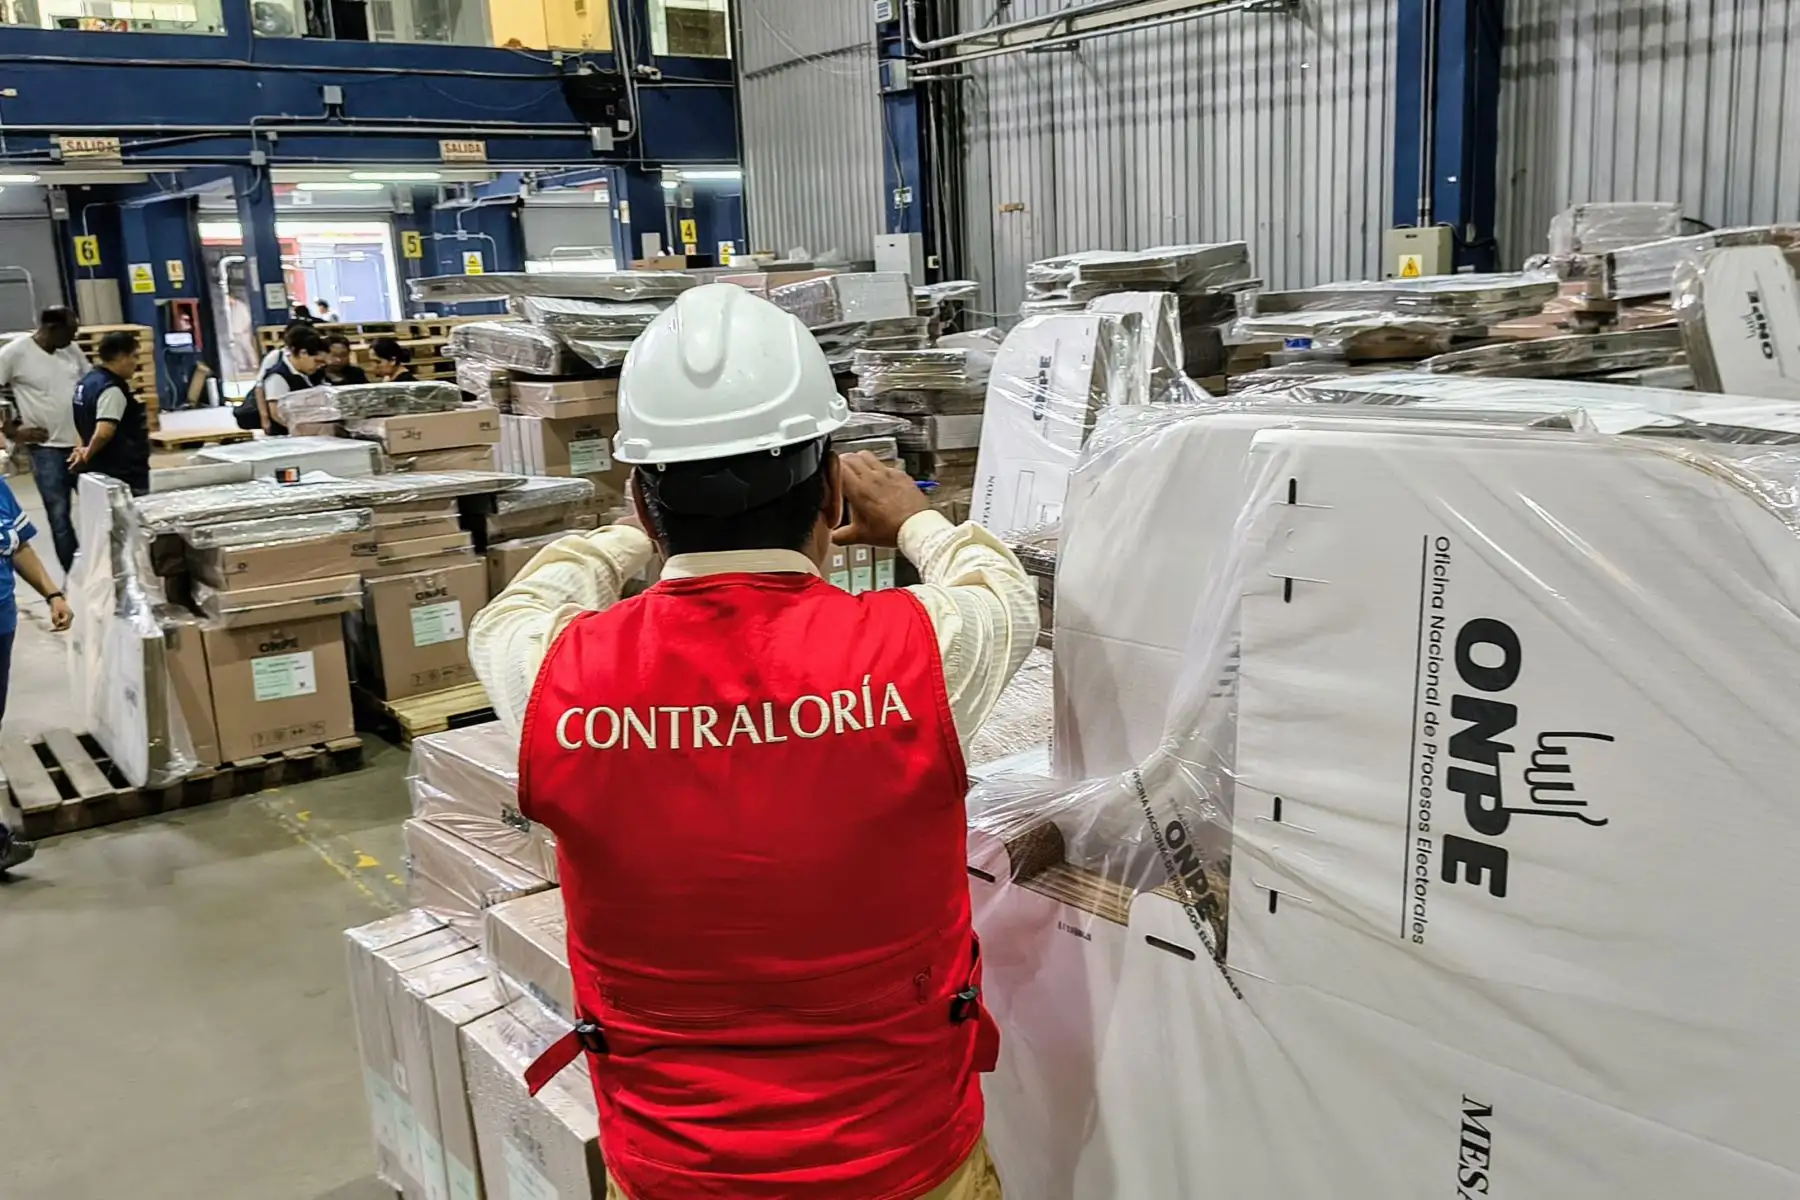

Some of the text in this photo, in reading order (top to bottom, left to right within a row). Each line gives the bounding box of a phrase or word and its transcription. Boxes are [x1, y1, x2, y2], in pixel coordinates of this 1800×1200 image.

[444, 143, 483, 153] SALIDA
[82, 240, 94, 260] 6
[407, 234, 417, 253] 5
[685, 223, 694, 239] 4
[555, 674, 913, 750] CONTRALORÍA
[1411, 536, 1451, 945] Oficina Nacional de Procesos Electorales
[1441, 617, 1522, 898] ONPE
[1165, 820, 1220, 922] ONPE
